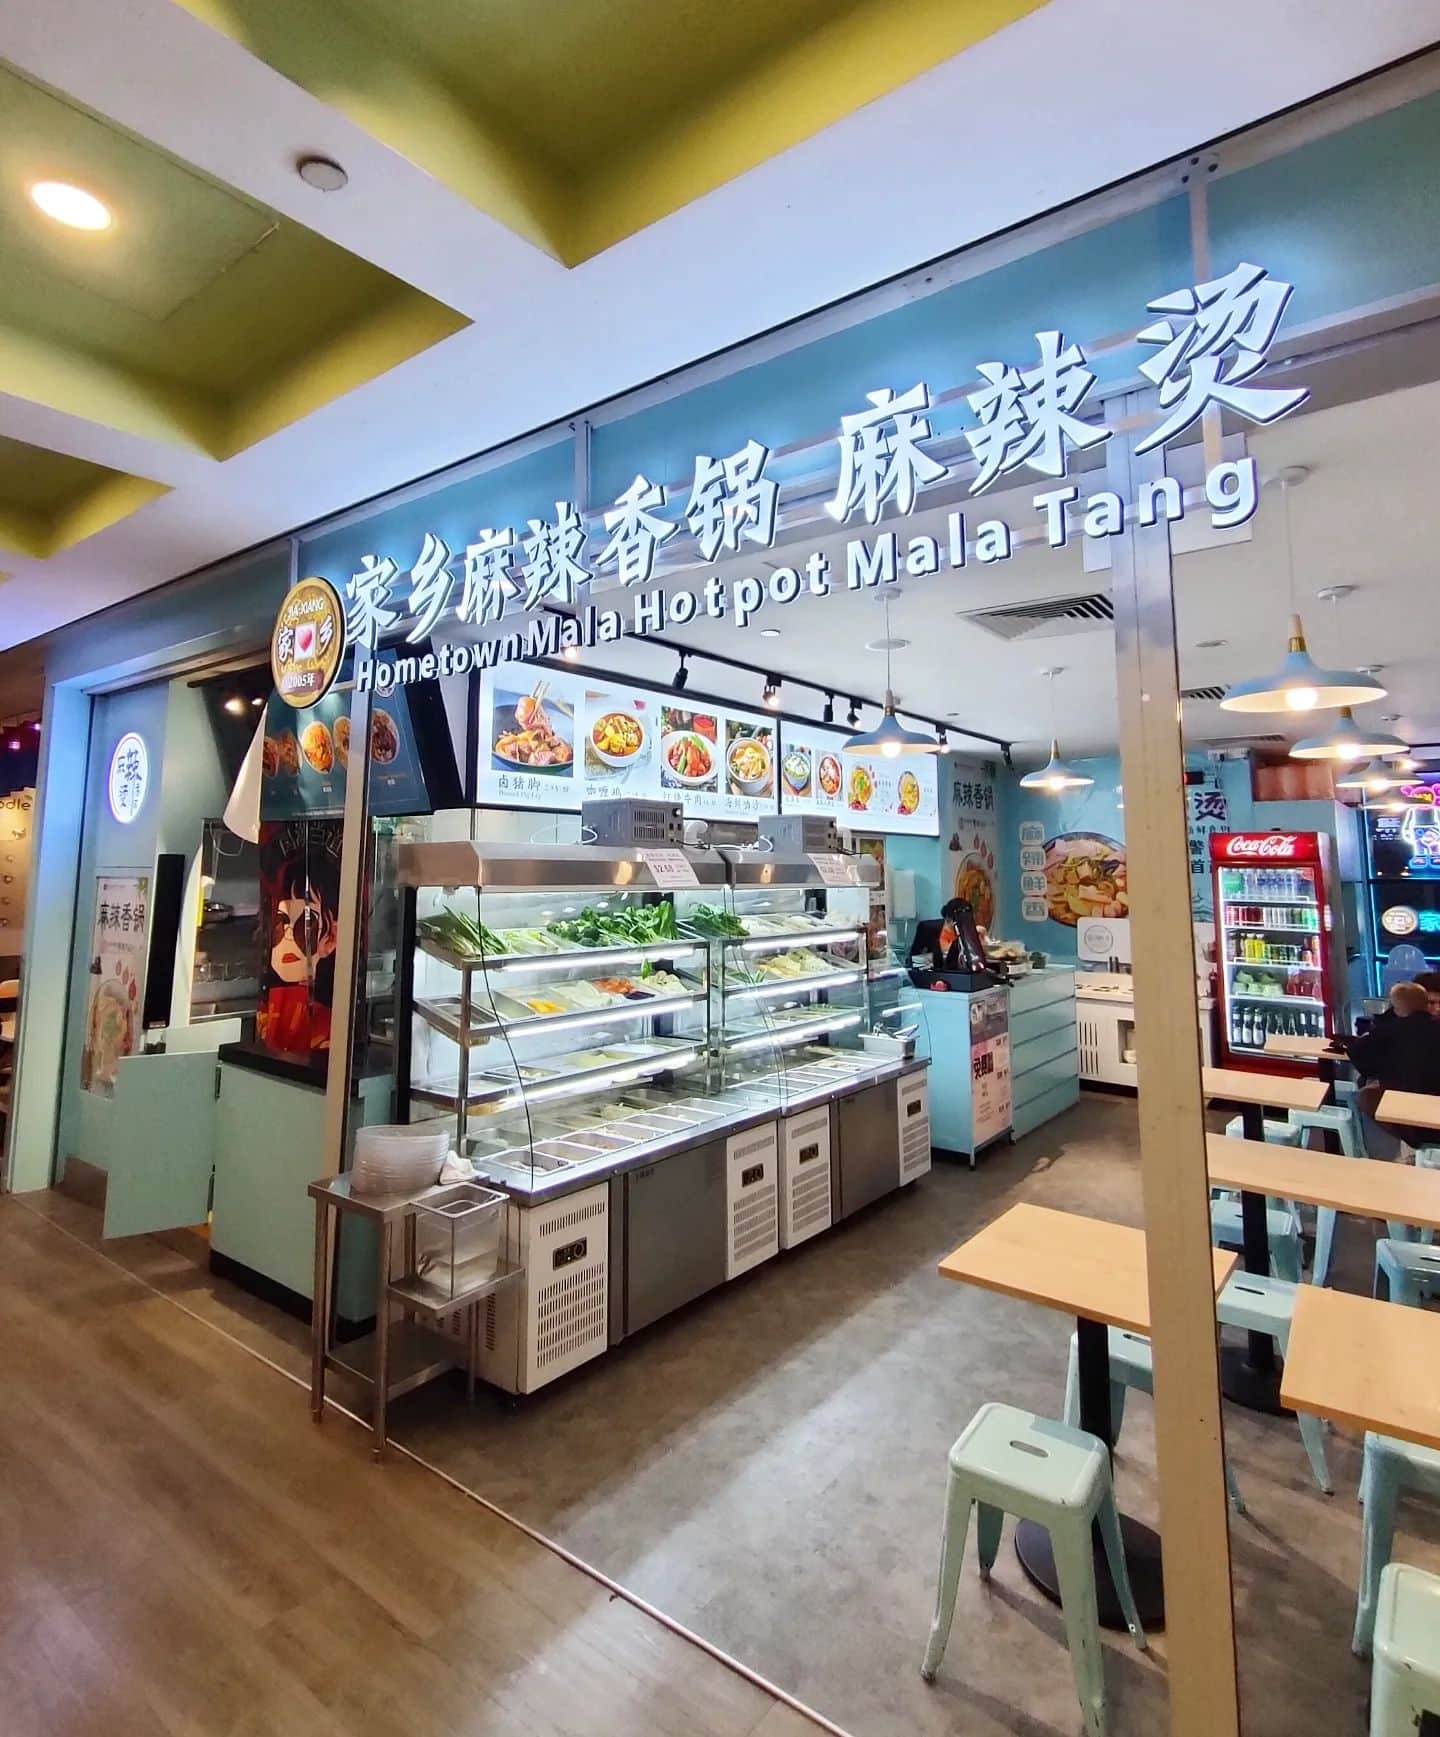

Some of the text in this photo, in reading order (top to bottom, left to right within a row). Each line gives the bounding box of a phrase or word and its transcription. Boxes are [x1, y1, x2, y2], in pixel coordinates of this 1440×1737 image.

[345, 262, 1310, 650] 家乡麻辣香锅 麻辣烫
[356, 456, 1258, 692] Hometown Mala Hotpot Mala Tang
